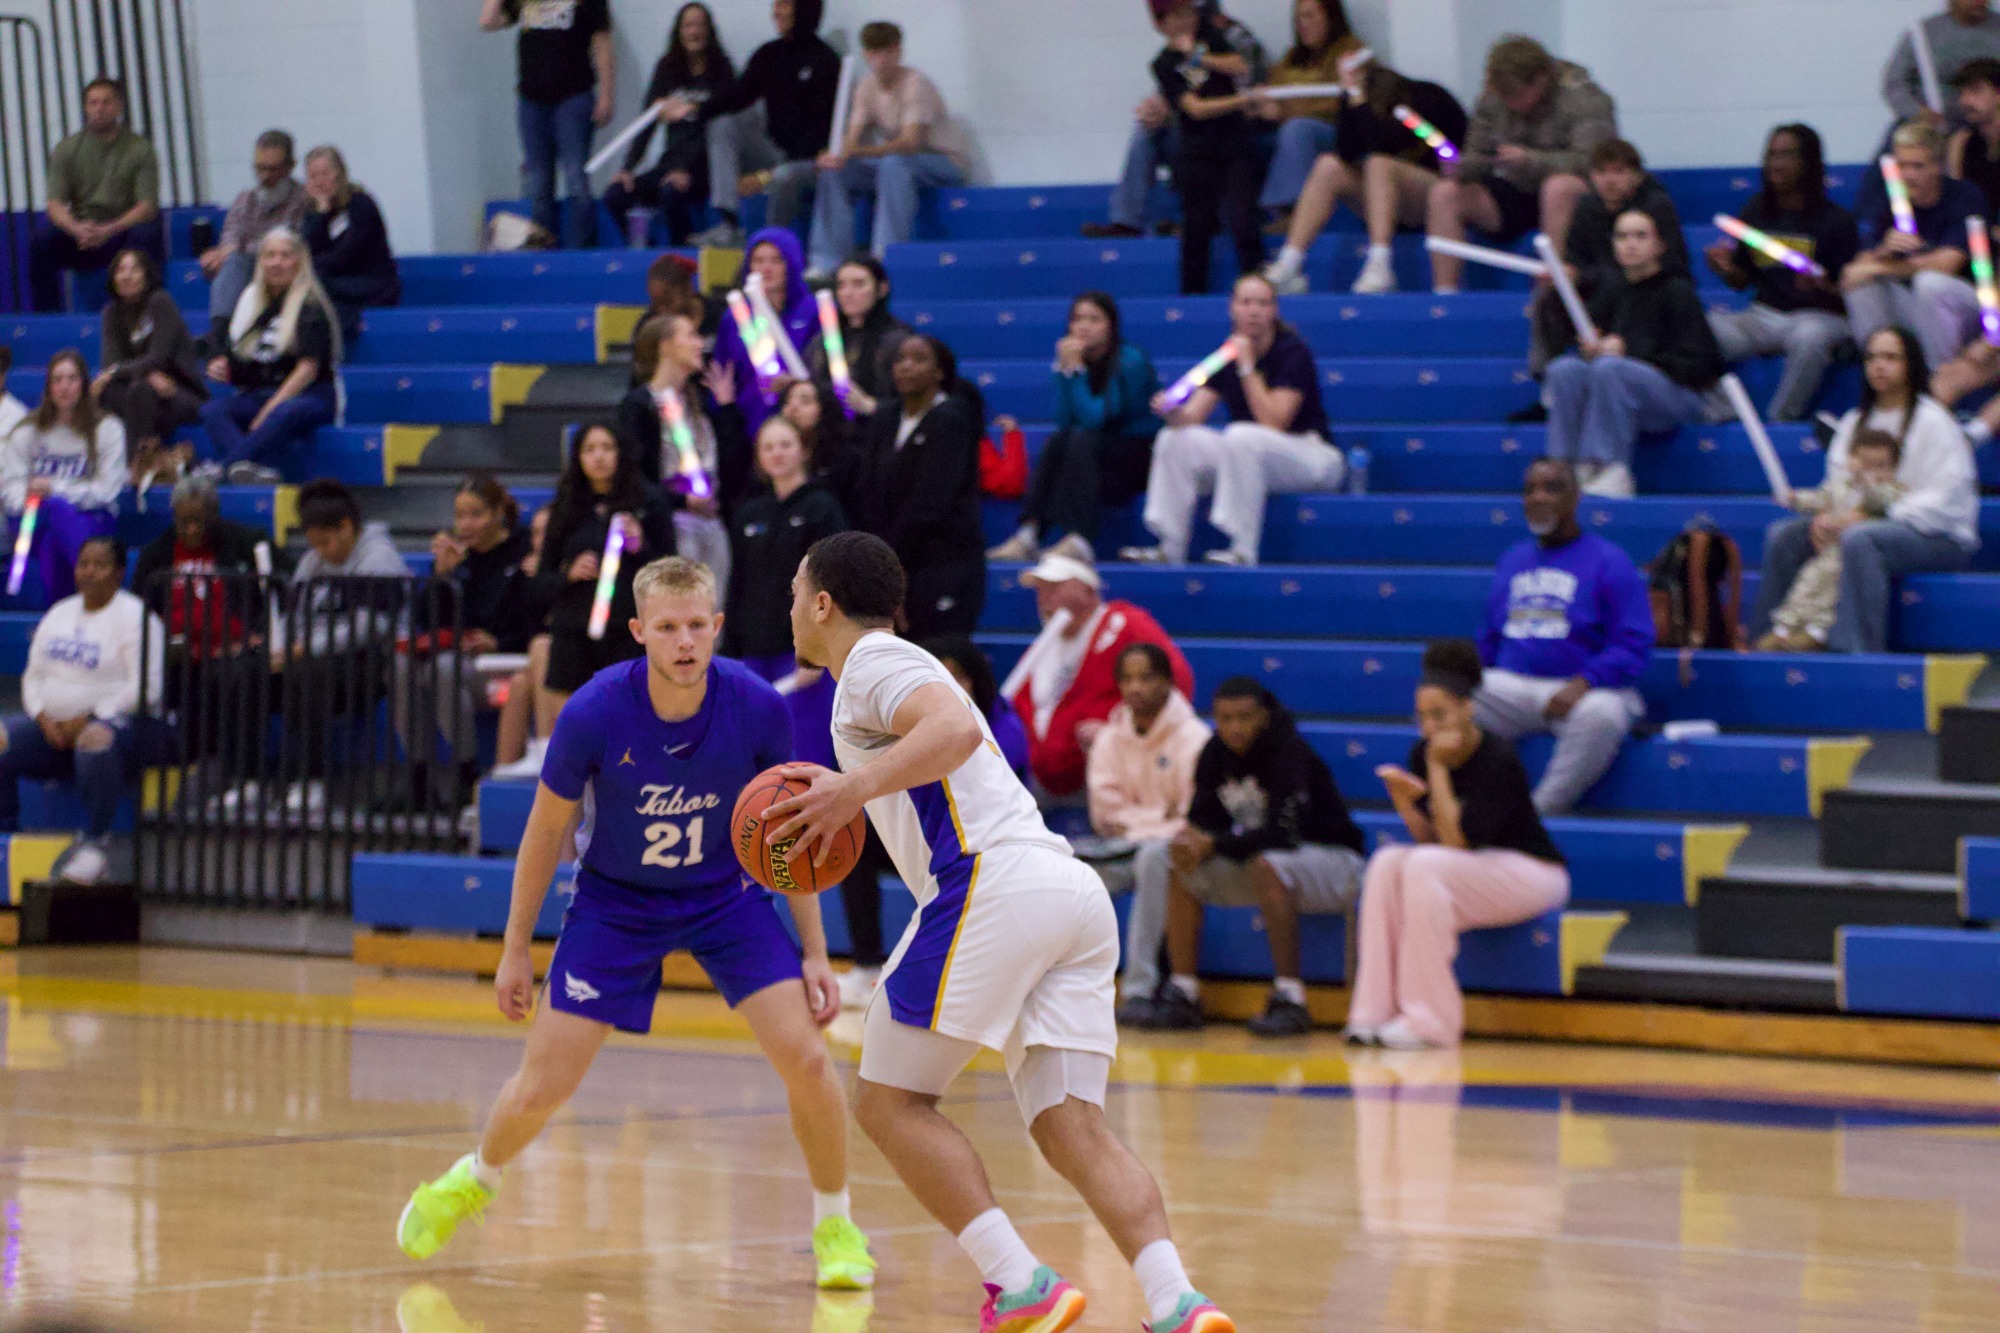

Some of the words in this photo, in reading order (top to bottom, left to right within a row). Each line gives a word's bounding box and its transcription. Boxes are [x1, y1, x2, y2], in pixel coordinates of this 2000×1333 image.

[635, 783, 720, 816] Tabor
[641, 816, 704, 868] 21
[769, 838, 803, 890] NAIA
